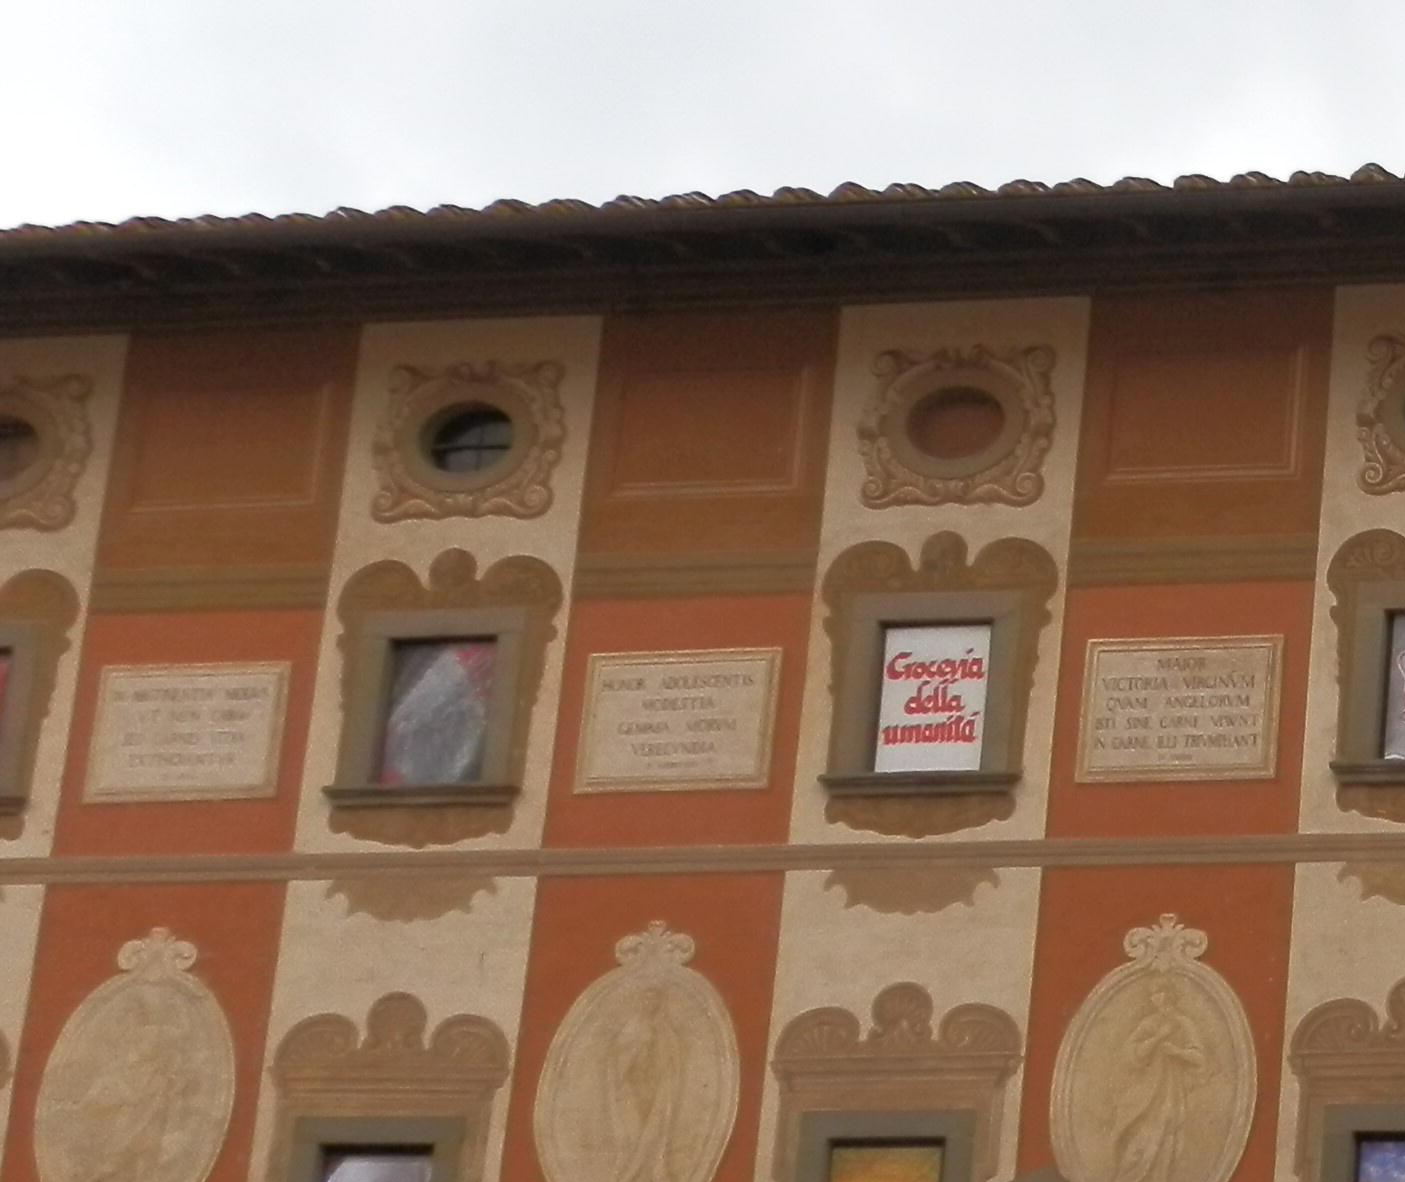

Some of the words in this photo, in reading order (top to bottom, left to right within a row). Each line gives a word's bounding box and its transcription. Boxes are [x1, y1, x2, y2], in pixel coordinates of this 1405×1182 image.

[1101, 676, 1169, 692] VICTORIA
[903, 678, 966, 716] della
[1105, 696, 1149, 713] QVAM
[1165, 694, 1251, 710] ANGELORVM
